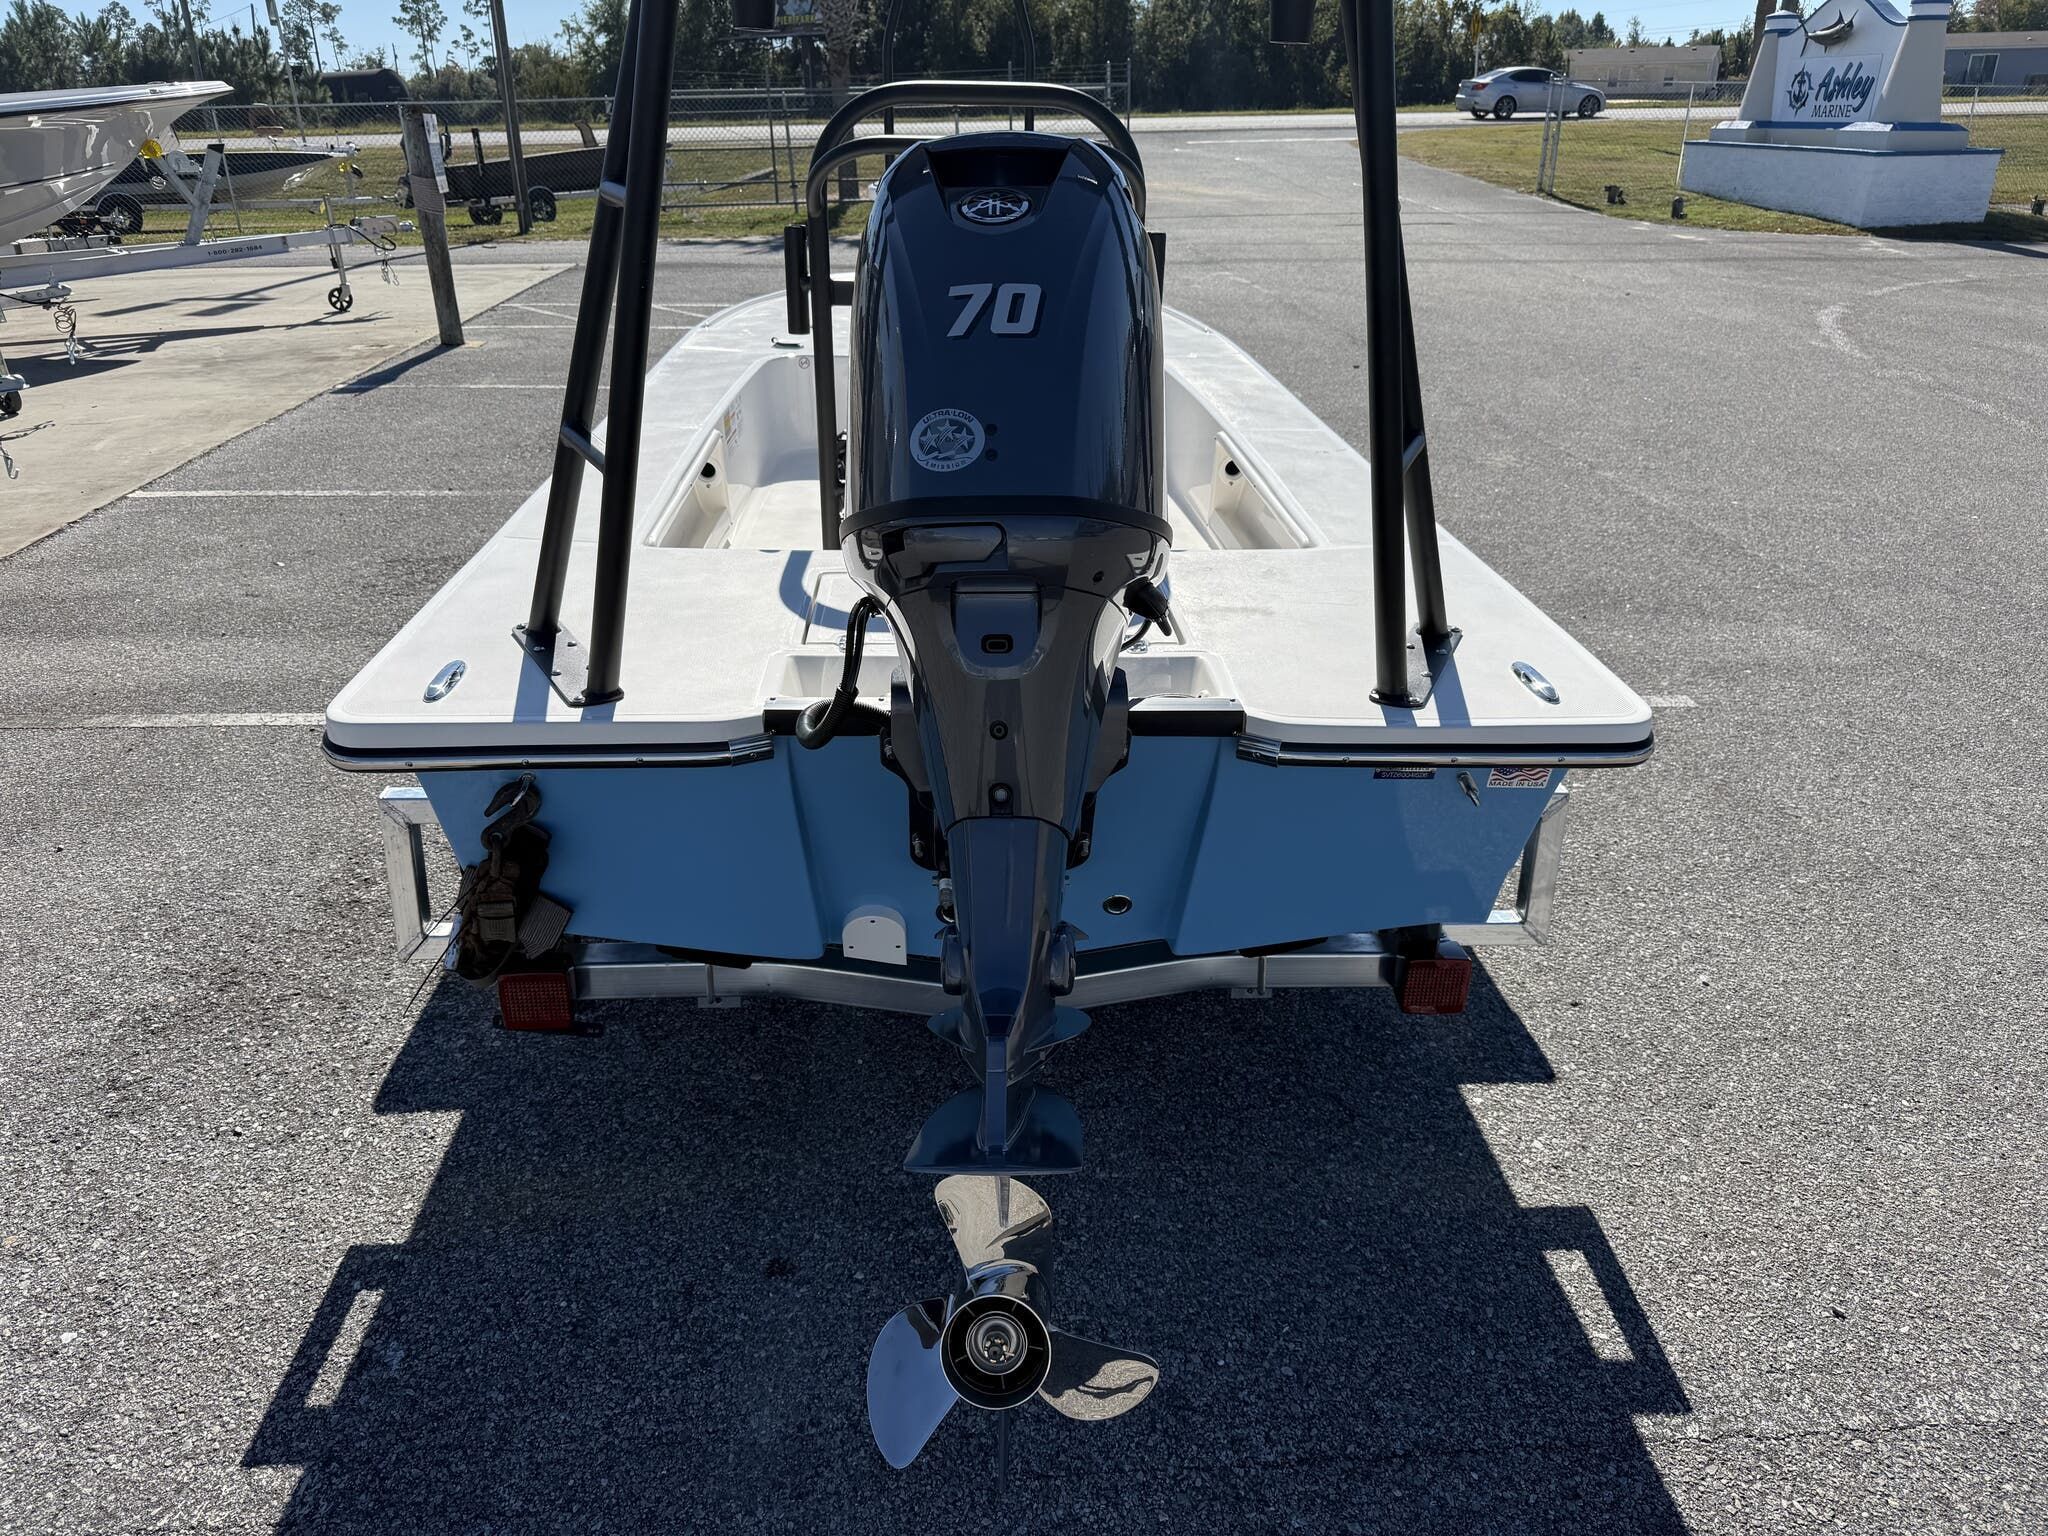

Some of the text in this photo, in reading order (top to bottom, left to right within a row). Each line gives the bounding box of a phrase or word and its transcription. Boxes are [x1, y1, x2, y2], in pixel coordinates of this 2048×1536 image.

[1815, 61, 1875, 113] Ashley
[1811, 104, 1852, 118] MARINE
[946, 283, 1042, 337] 70
[922, 410, 974, 424] ULTRA LOW
